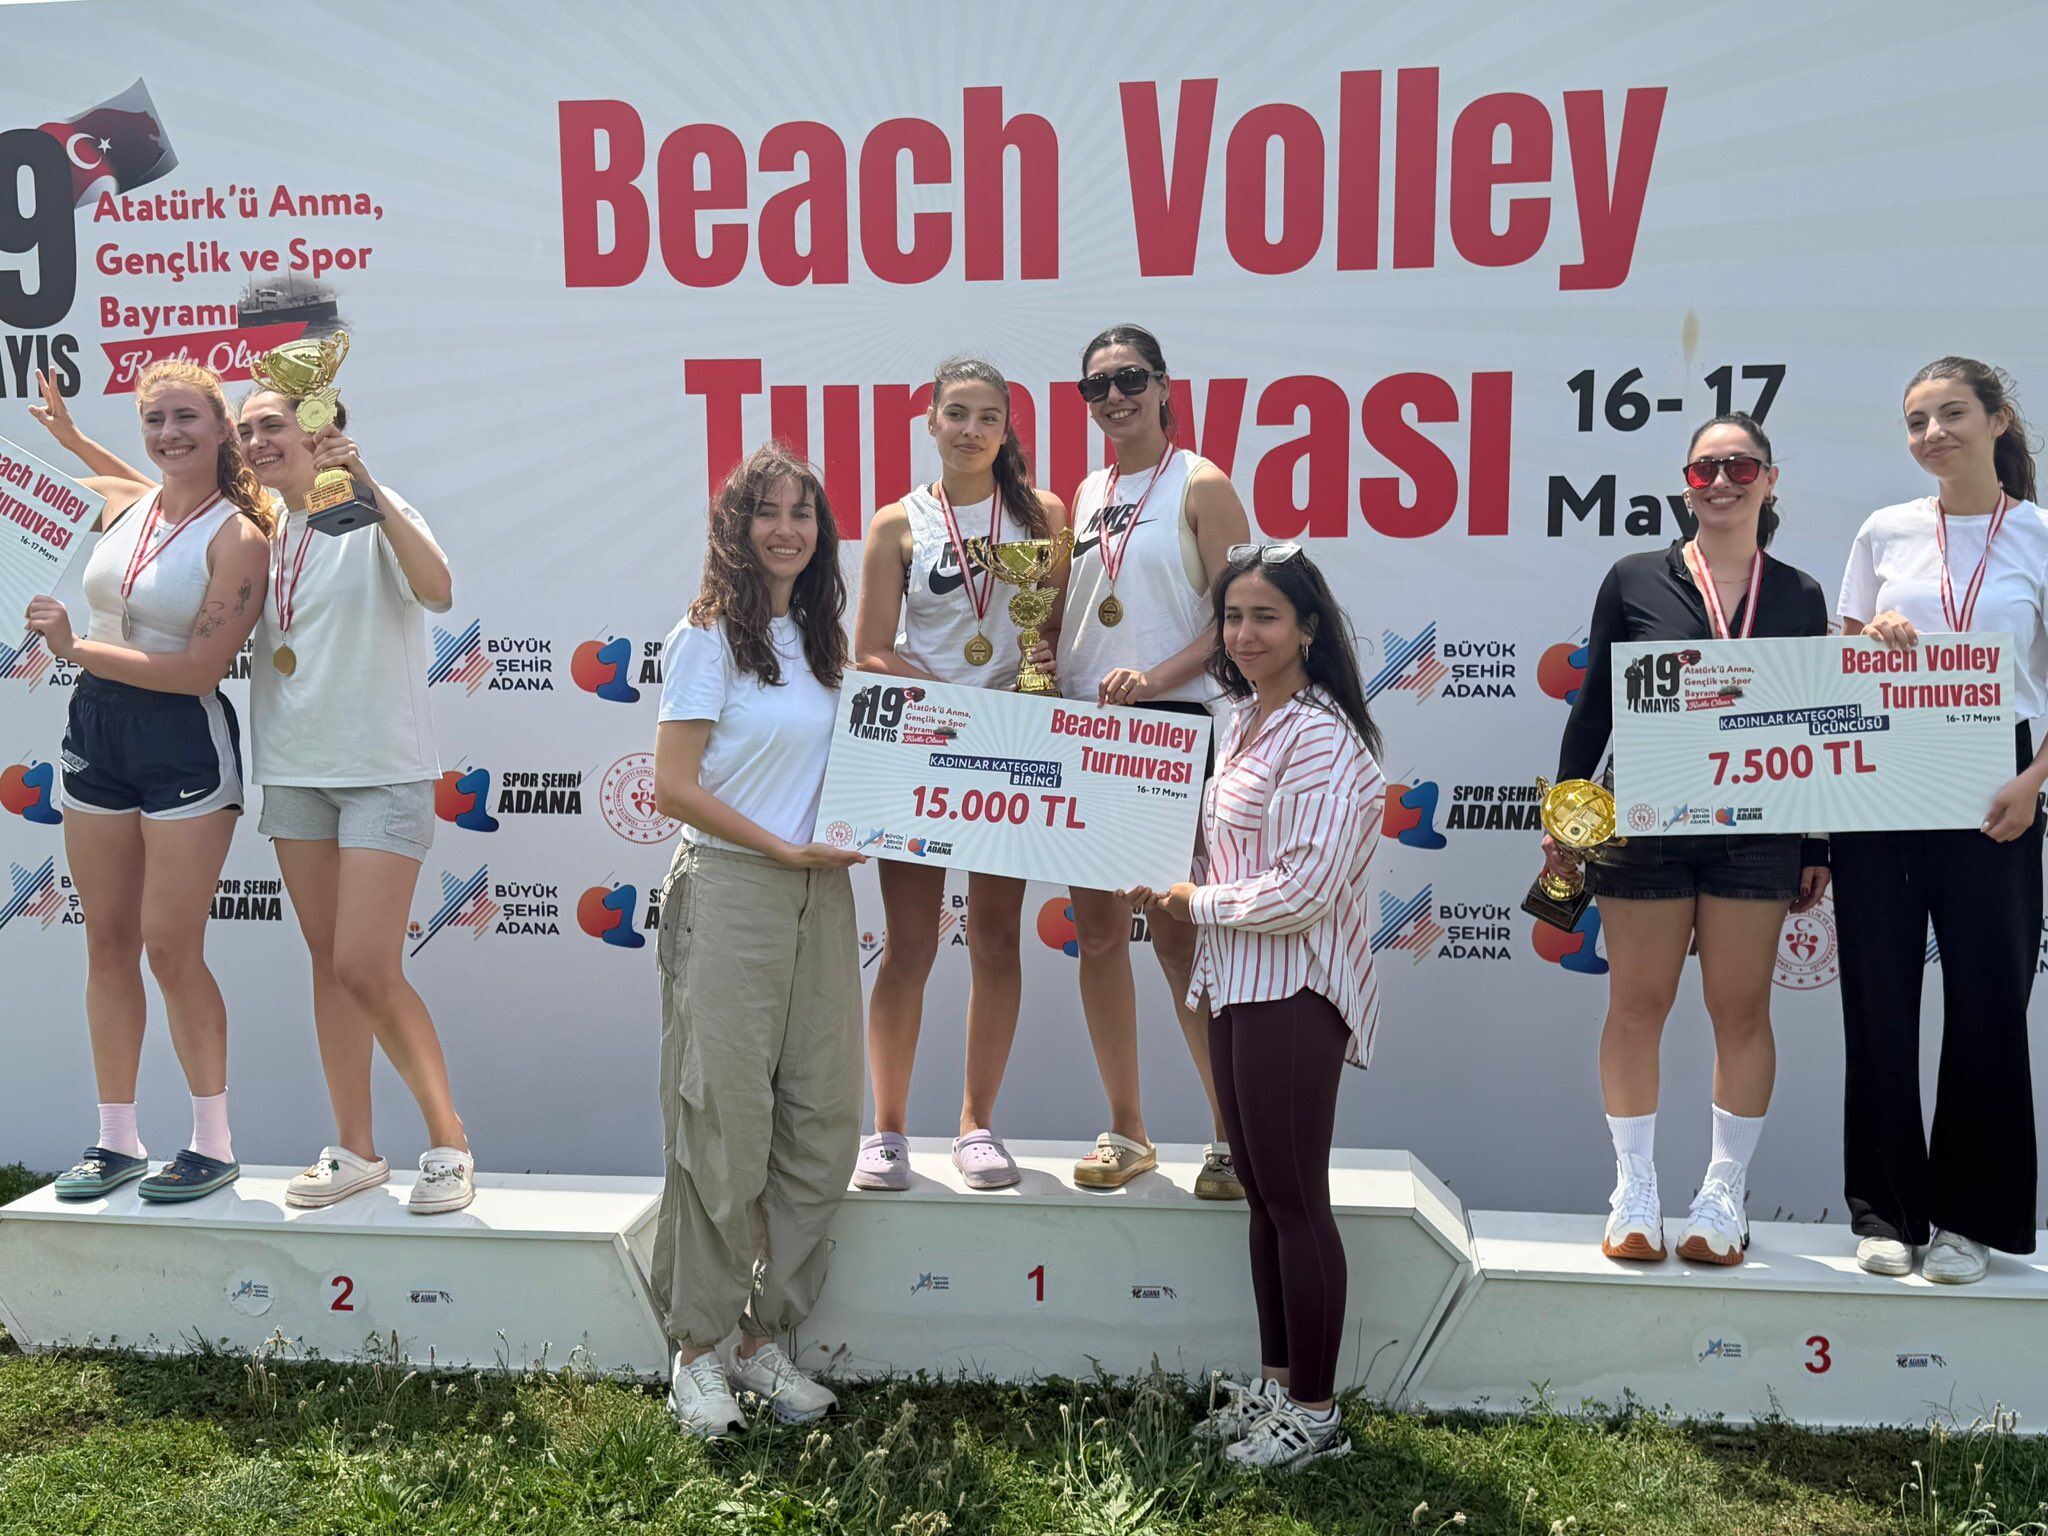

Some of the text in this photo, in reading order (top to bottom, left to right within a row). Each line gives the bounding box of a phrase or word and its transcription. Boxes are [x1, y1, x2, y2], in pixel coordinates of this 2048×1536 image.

[558, 67, 1669, 291] Beach Volley
[93, 184, 384, 223] Atatürk'ü Anma,
[95, 237, 373, 282] Gençlik ve Spor
[99, 296, 238, 335] Bayramı
[0, 334, 81, 399] YIS
[33, 474, 91, 524] Volley
[487, 637, 551, 653] BÜYÜK
[1443, 640, 1516, 658] BÜYÜK
[495, 656, 552, 677] ŞEHİR
[1842, 643, 2001, 674] Beach Volley
[1451, 660, 1516, 683] ŞEHİR
[1638, 653, 1680, 698] 19
[488, 677, 554, 691] ADANA
[1441, 684, 1516, 698] ADANA
[1880, 682, 2000, 709] Turnuvası
[866, 685, 904, 728] 19
[1641, 698, 1680, 713] MAYIS
[1720, 703, 1861, 730] KADINLAR KATEGORİSİ
[861, 725, 898, 743] MAYIS
[948, 718, 967, 728] Spor
[1051, 708, 1198, 753] Beach Volley
[1812, 717, 1883, 735] ÜÇÜNCÜSÜ
[930, 756, 1062, 776] KADINLAR KATEGORİSİ
[1081, 746, 1192, 785] Turnuvası
[1708, 739, 1876, 785] 7.500 TL
[502, 770, 582, 791] SPOR ŞEHRİ
[1013, 774, 1058, 788] BİRİNCİ
[497, 789, 582, 814] ADANA
[1453, 785, 1540, 804] SPOR ŞEHR
[913, 785, 1086, 830] 15.000 TL
[1446, 804, 1543, 830] ADANA
[215, 877, 282, 897] POR ŞEHRİ
[495, 882, 558, 898] BÜYÜK
[503, 903, 558, 921] ŞEHİR
[1440, 903, 1511, 920] BÜYÜK
[495, 922, 560, 935] ADANA
[1447, 923, 1511, 944] ŞEHİR
[1438, 946, 1512, 960] ADANA
[330, 1275, 354, 1312] 2
[1028, 1265, 1044, 1301] 1
[1804, 1335, 1832, 1374] 3
